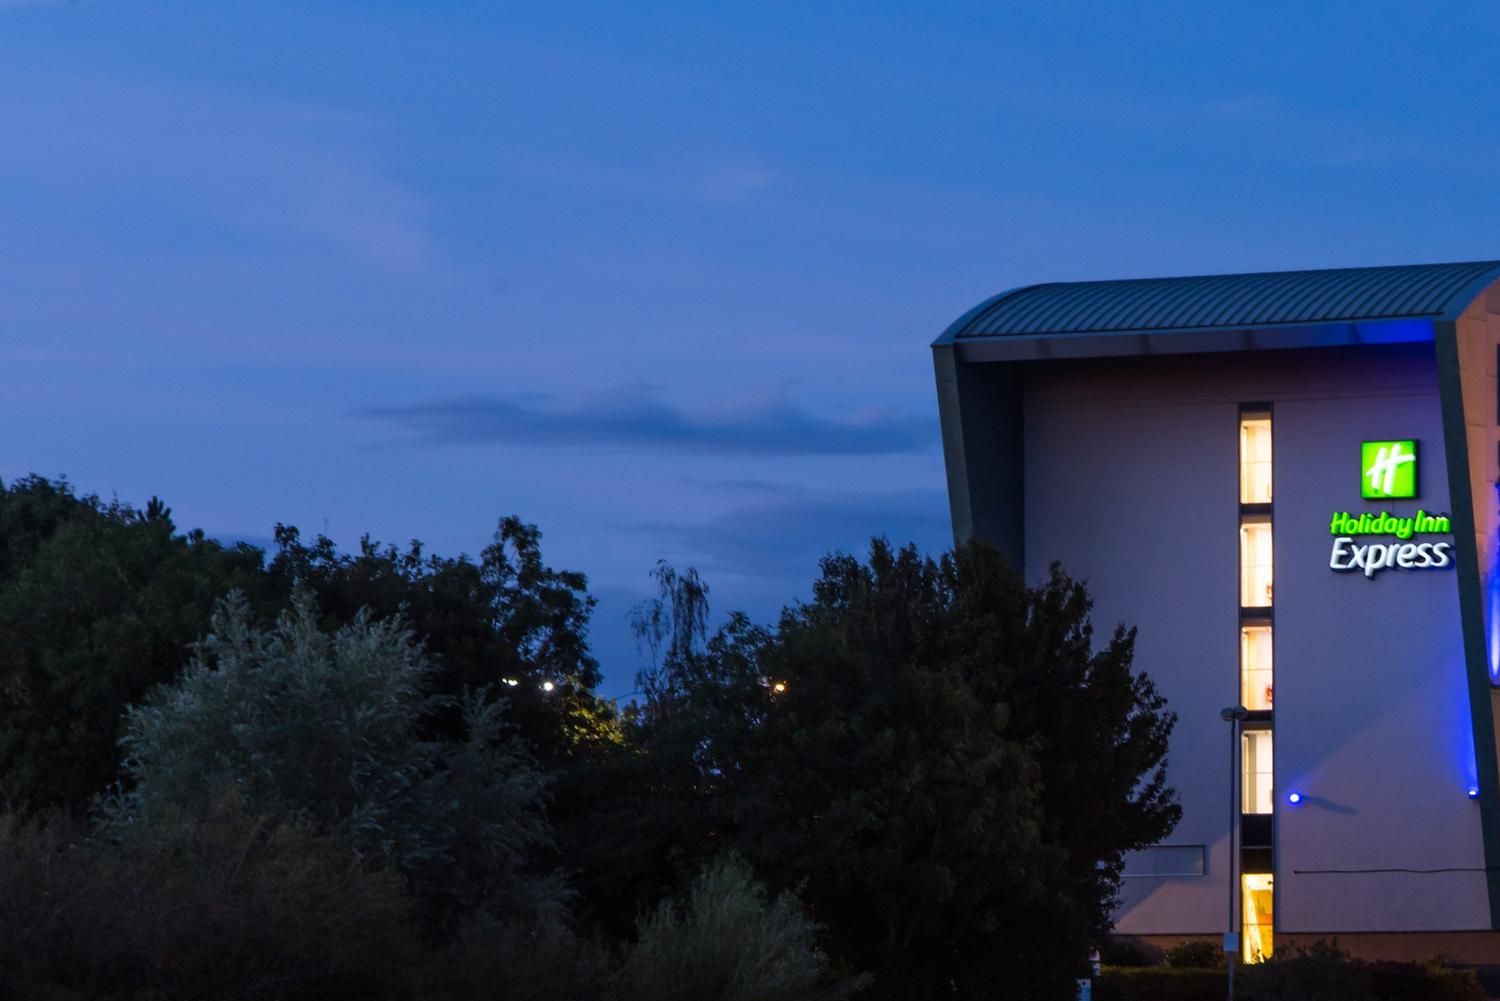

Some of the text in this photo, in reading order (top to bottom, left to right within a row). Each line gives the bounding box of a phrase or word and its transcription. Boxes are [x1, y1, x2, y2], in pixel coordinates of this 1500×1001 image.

[1329, 509, 1451, 539] Holiday Inn
[1329, 537, 1451, 577] Express
